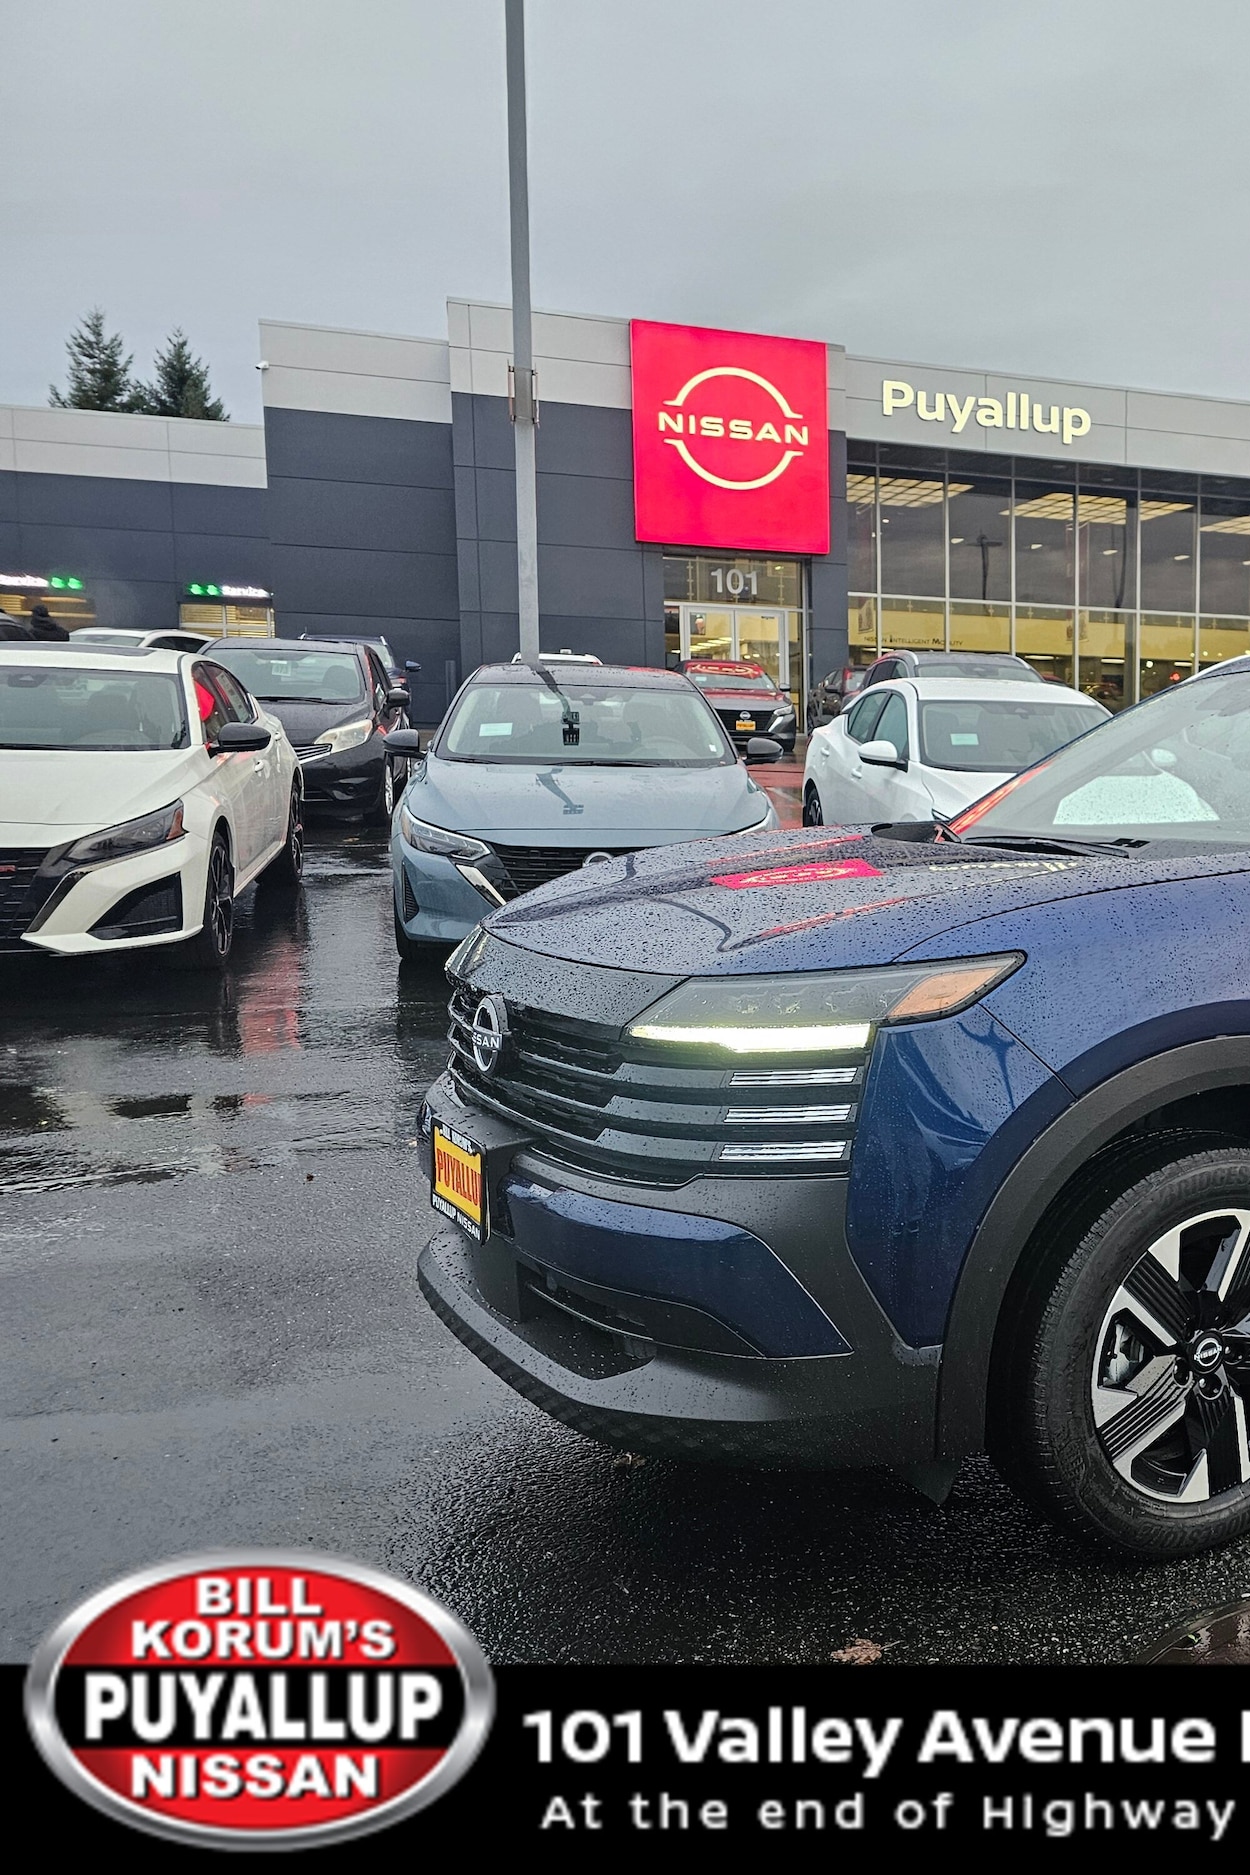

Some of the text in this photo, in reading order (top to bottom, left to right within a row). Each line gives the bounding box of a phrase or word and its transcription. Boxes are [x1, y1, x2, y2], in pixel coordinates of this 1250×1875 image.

[658, 410, 809, 447] NISSAN
[882, 379, 1093, 444] Puyallup
[710, 568, 758, 596] 101
[456, 1210, 480, 1241] NISSAN
